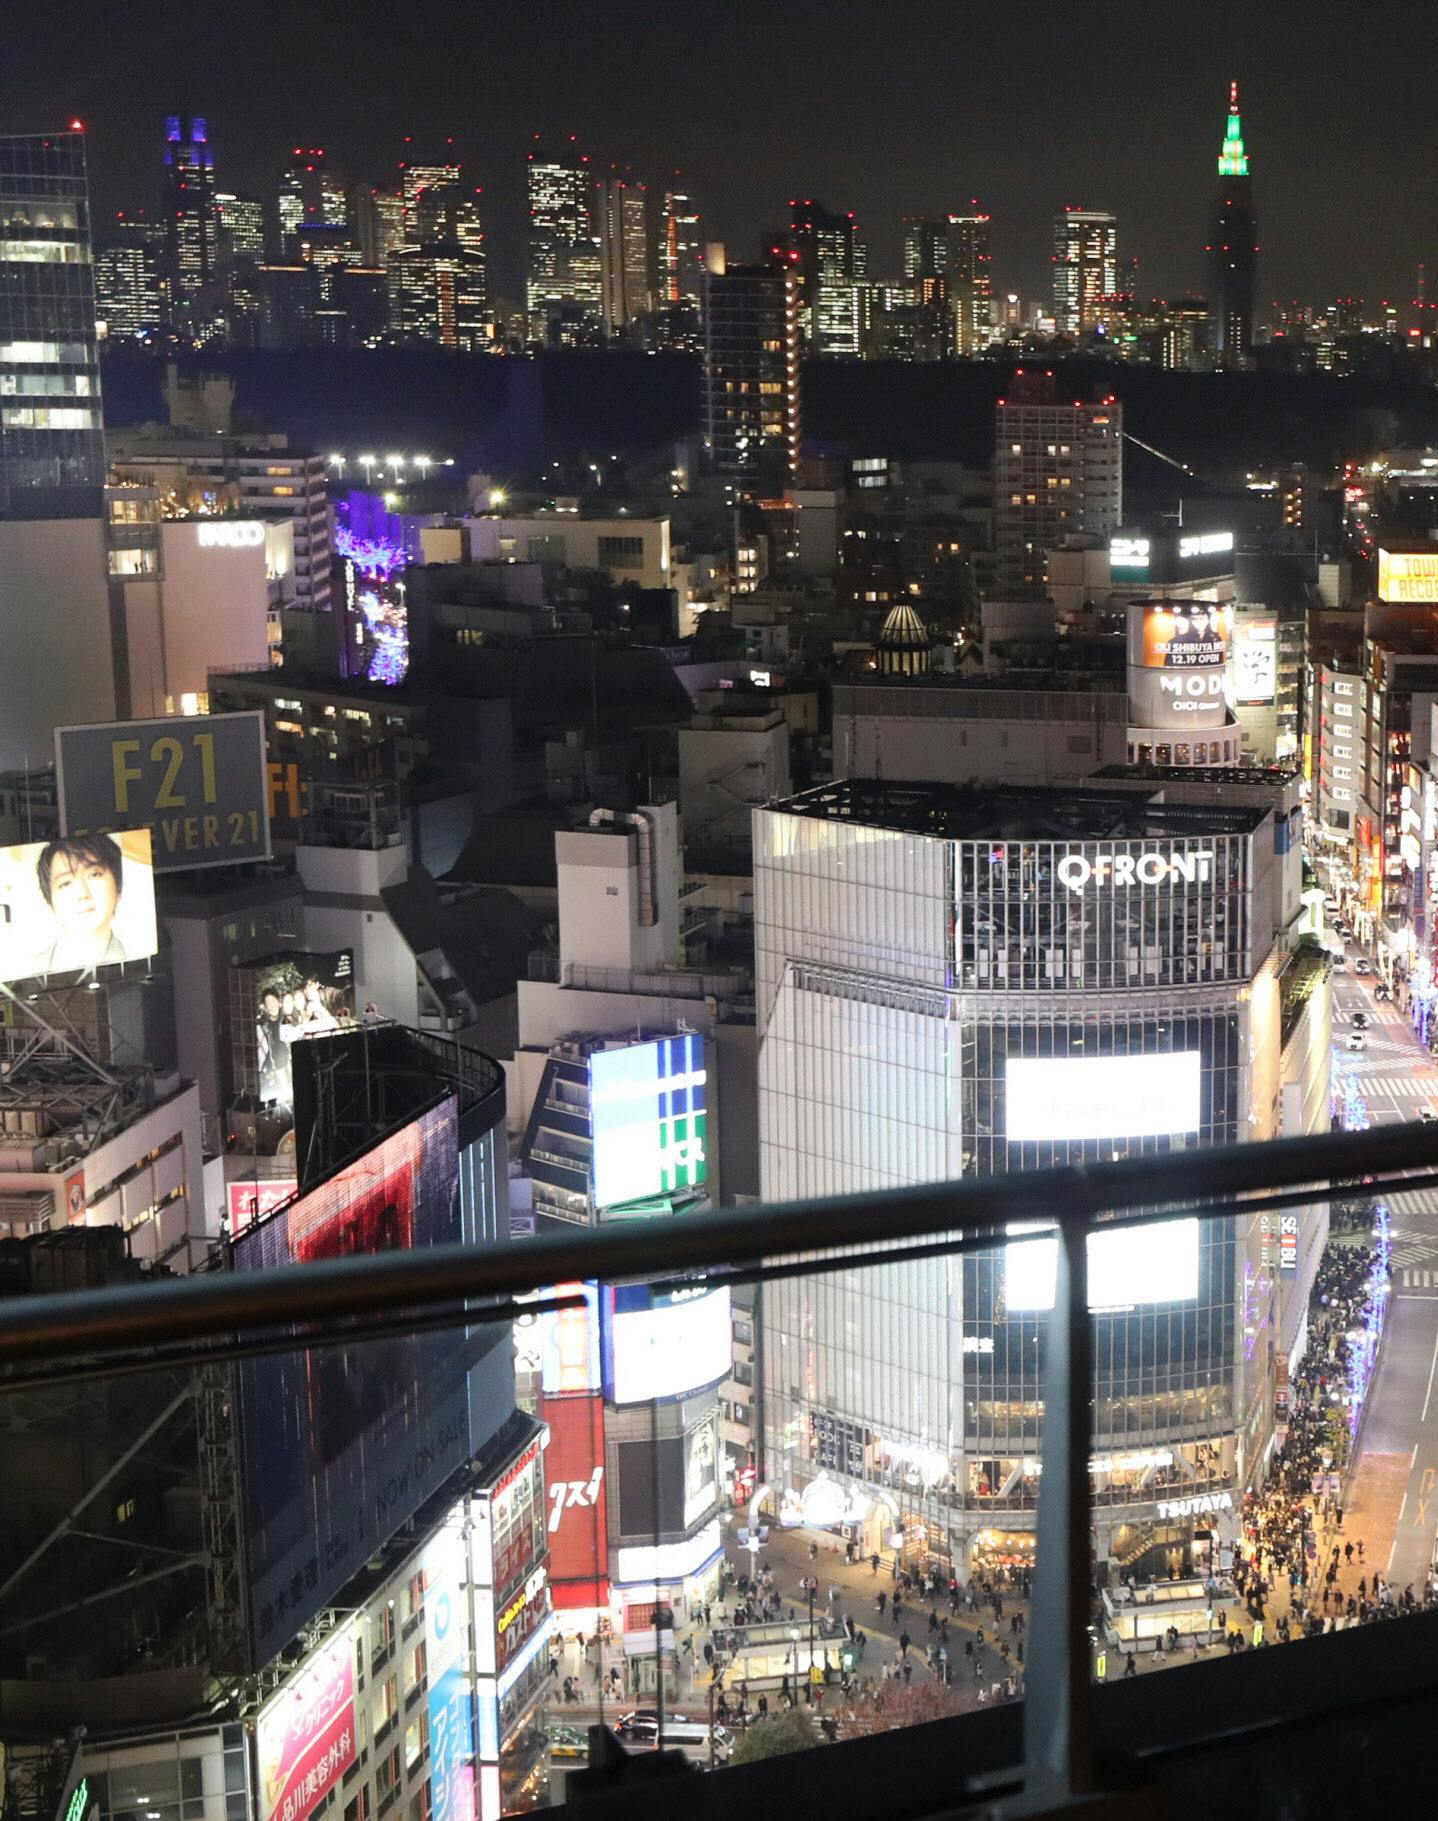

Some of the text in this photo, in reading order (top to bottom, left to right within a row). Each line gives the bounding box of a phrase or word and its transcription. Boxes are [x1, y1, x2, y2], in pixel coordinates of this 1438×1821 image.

[1171, 653, 1220, 665] 12.19 OPEN
[1172, 642, 1212, 652] SHIBUYA
[112, 733, 217, 813] F21
[228, 810, 260, 846] 21
[1057, 851, 1214, 896] QFRONT
[237, 1188, 290, 1213] わた
[1279, 1216, 1297, 1269] SEIBU
[374, 1476, 411, 1516] NOW
[413, 1447, 435, 1480] ON
[1156, 1492, 1233, 1519] TSUTAYA
